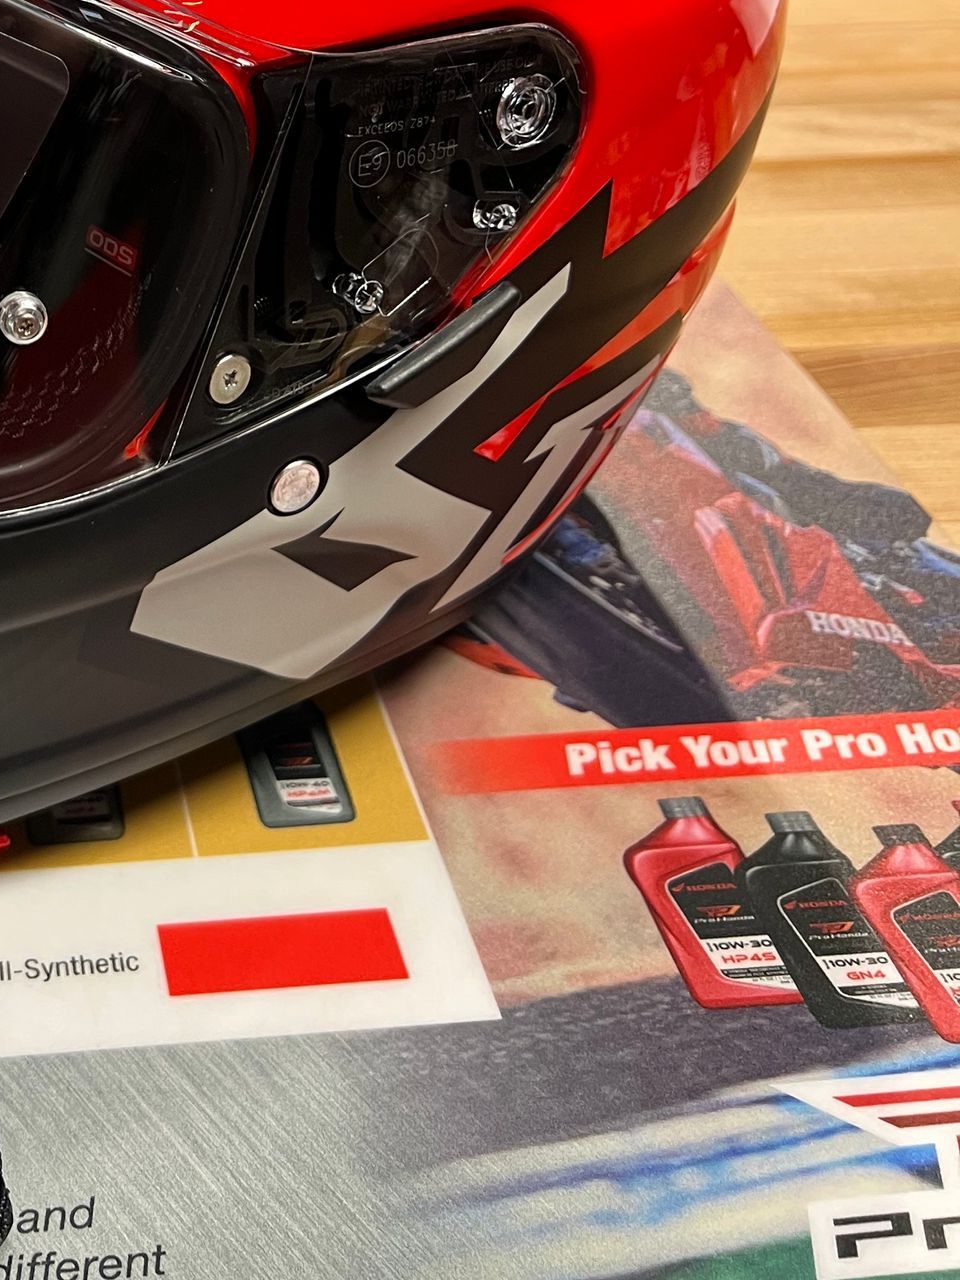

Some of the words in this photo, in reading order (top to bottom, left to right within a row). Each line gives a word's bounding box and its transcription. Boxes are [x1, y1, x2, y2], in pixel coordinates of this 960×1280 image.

[89, 230, 134, 266] ODS
[805, 609, 914, 647] HONDA
[564, 738, 679, 778] Pick
[680, 734, 788, 767] Your
[800, 728, 888, 762] Pro
[896, 722, 960, 755] Ho
[721, 952, 777, 964] HP4S
[846, 970, 887, 981] GN4
[17, 1196, 96, 1234] and
